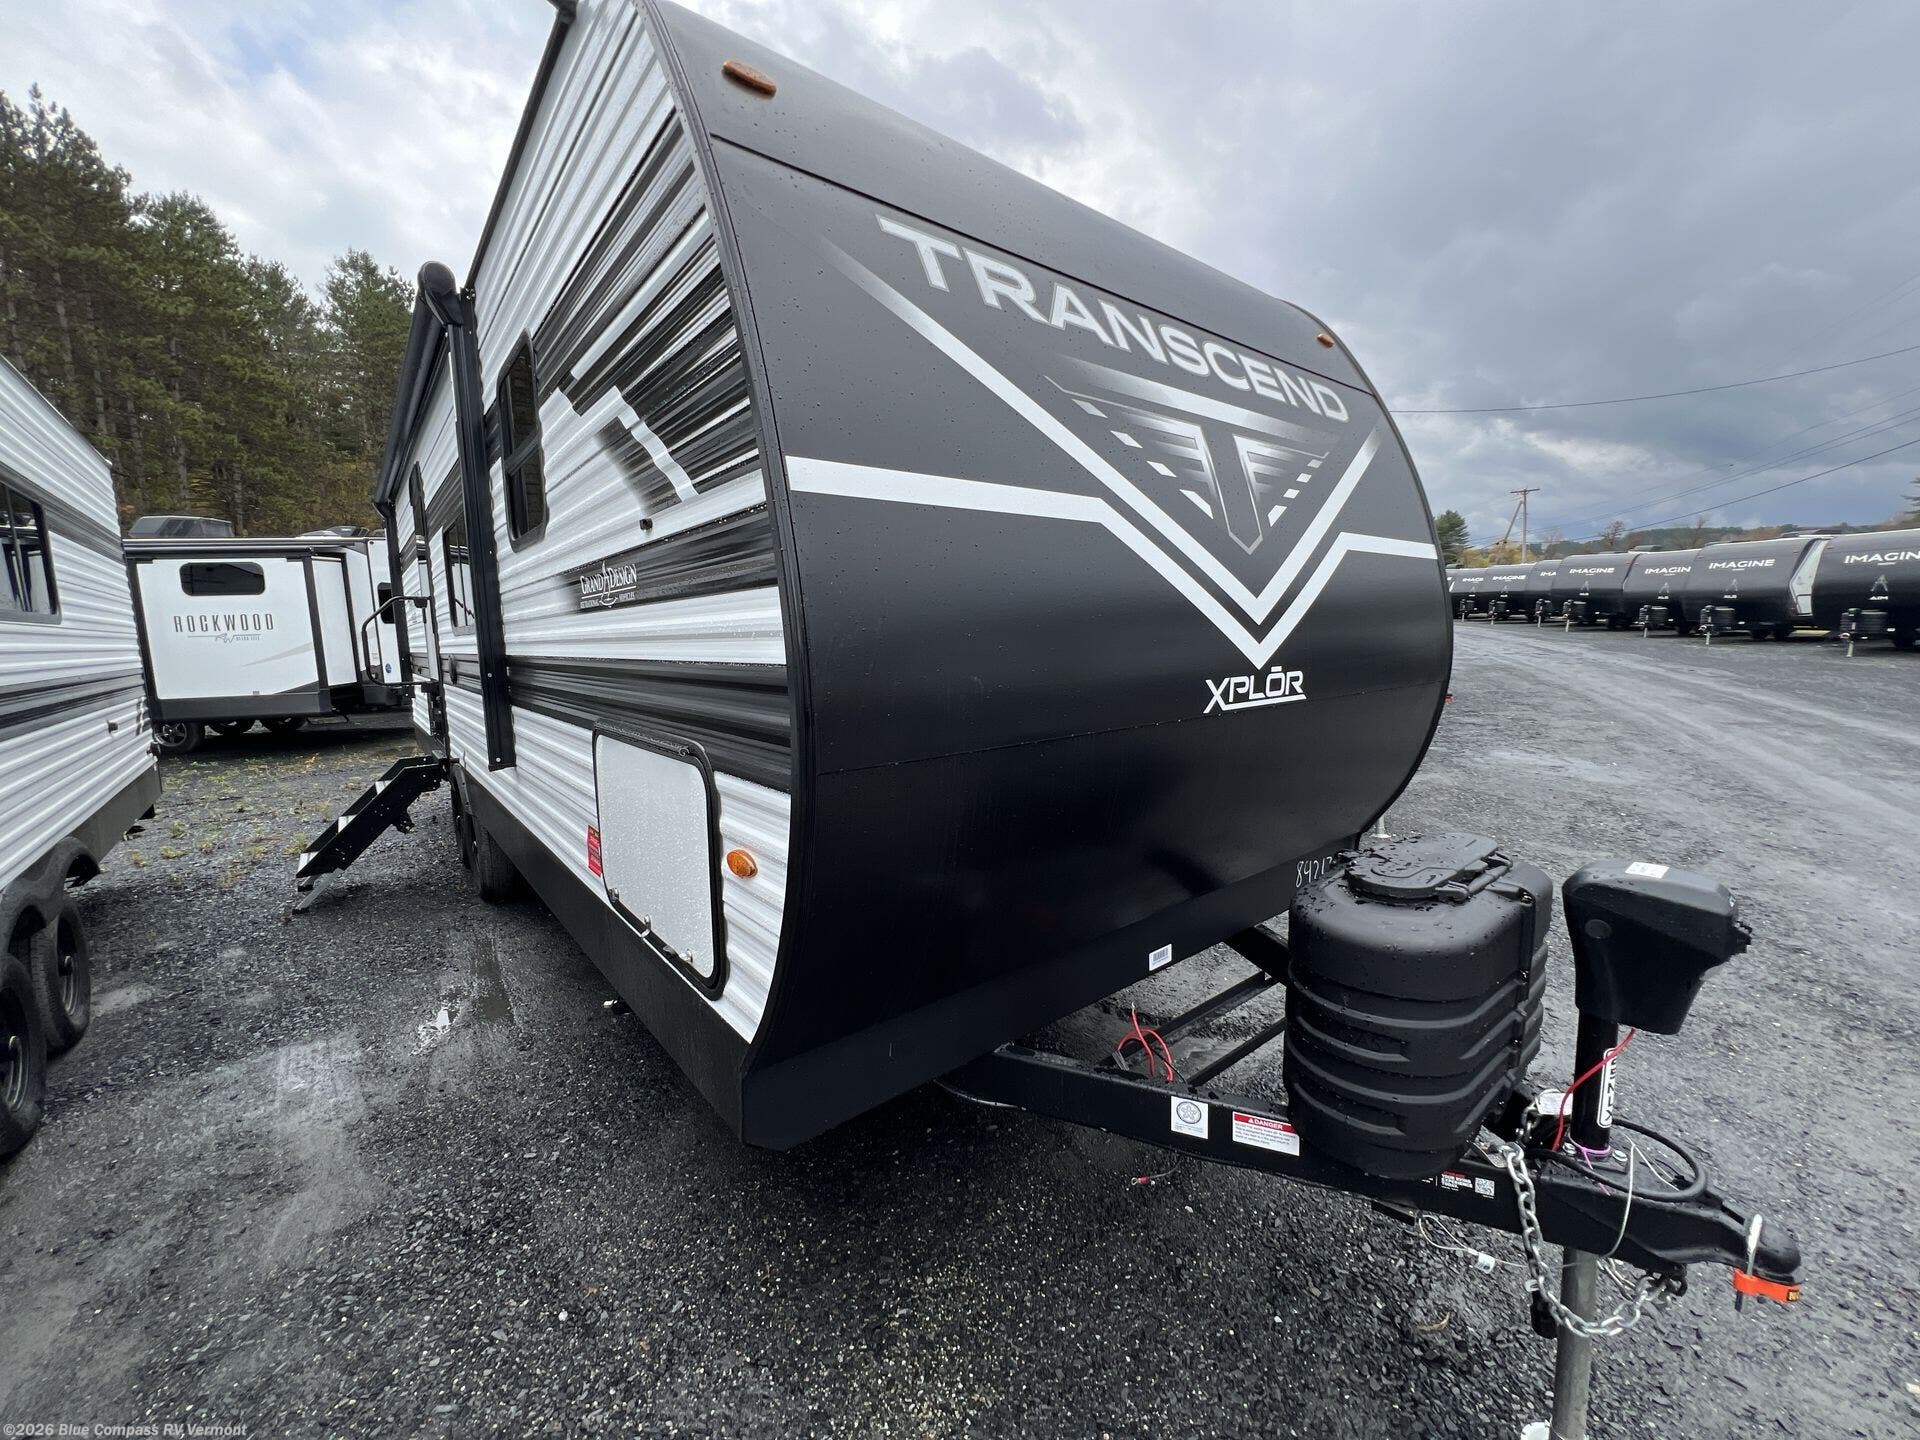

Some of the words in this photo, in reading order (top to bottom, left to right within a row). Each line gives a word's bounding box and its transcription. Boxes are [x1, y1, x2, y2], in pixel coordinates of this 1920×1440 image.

[875, 214, 1350, 423] TRANSCEND
[1708, 559, 1776, 570] IMAGINE
[580, 574, 604, 594] GRAND
[607, 563, 638, 588] DESIGN
[173, 613, 274, 633] ROCKWOOD
[1254, 1119, 1283, 1130] DANGER
